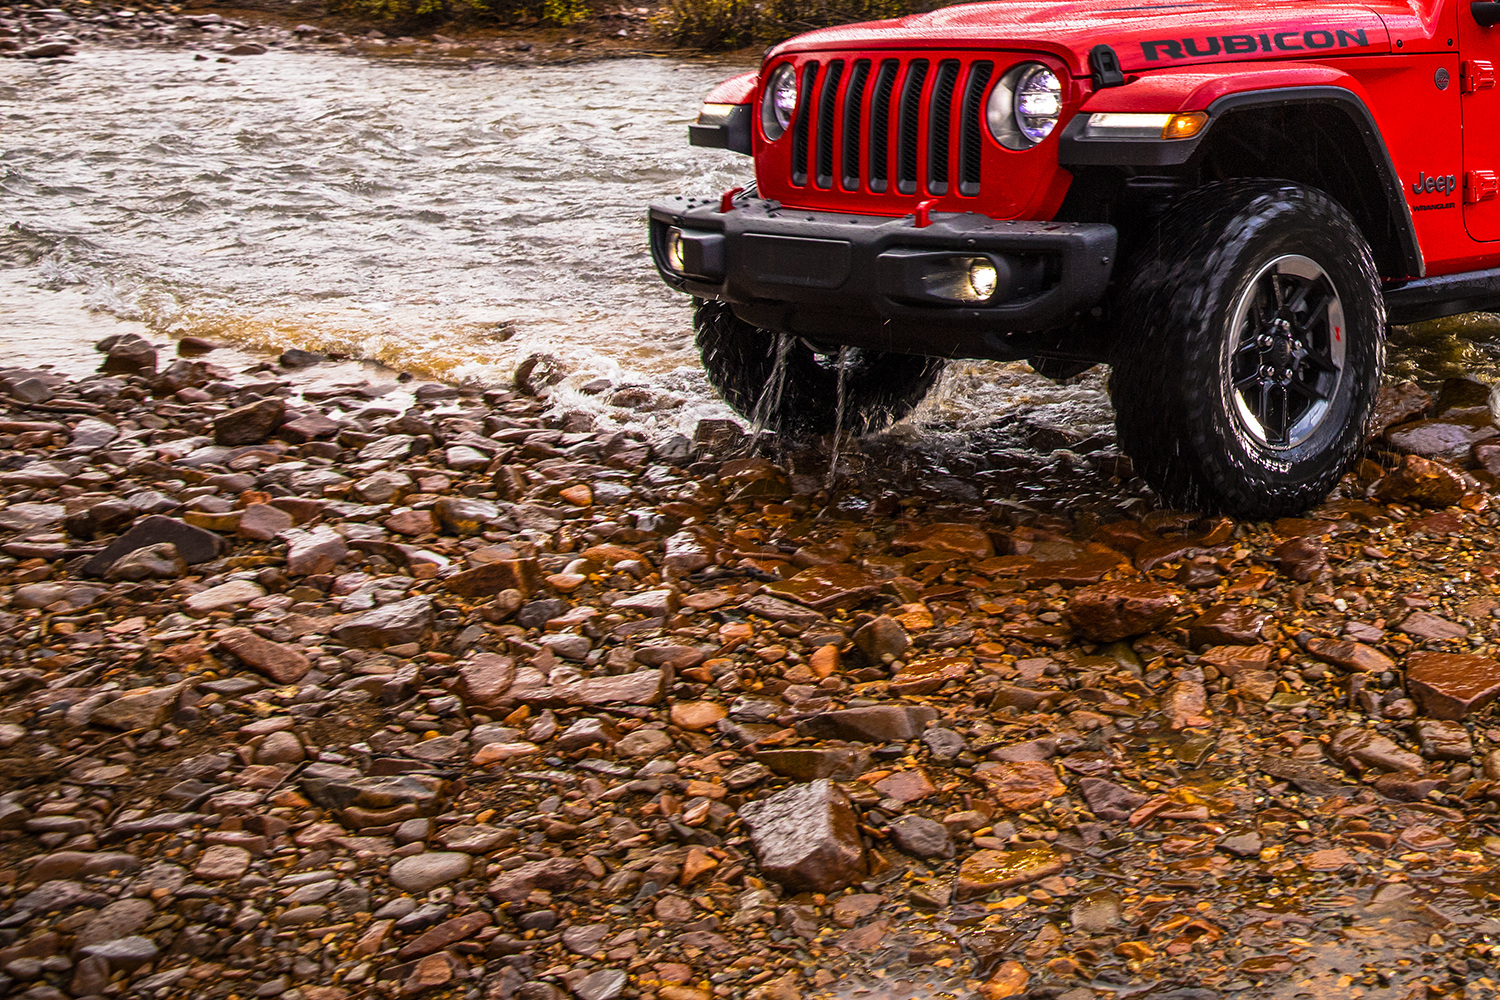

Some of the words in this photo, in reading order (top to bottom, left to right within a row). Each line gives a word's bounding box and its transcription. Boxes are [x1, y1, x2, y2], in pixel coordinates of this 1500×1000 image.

[1139, 29, 1370, 61] RUBICON
[1412, 171, 1457, 196] Jeep
[1412, 202, 1456, 212] WRANGLER
